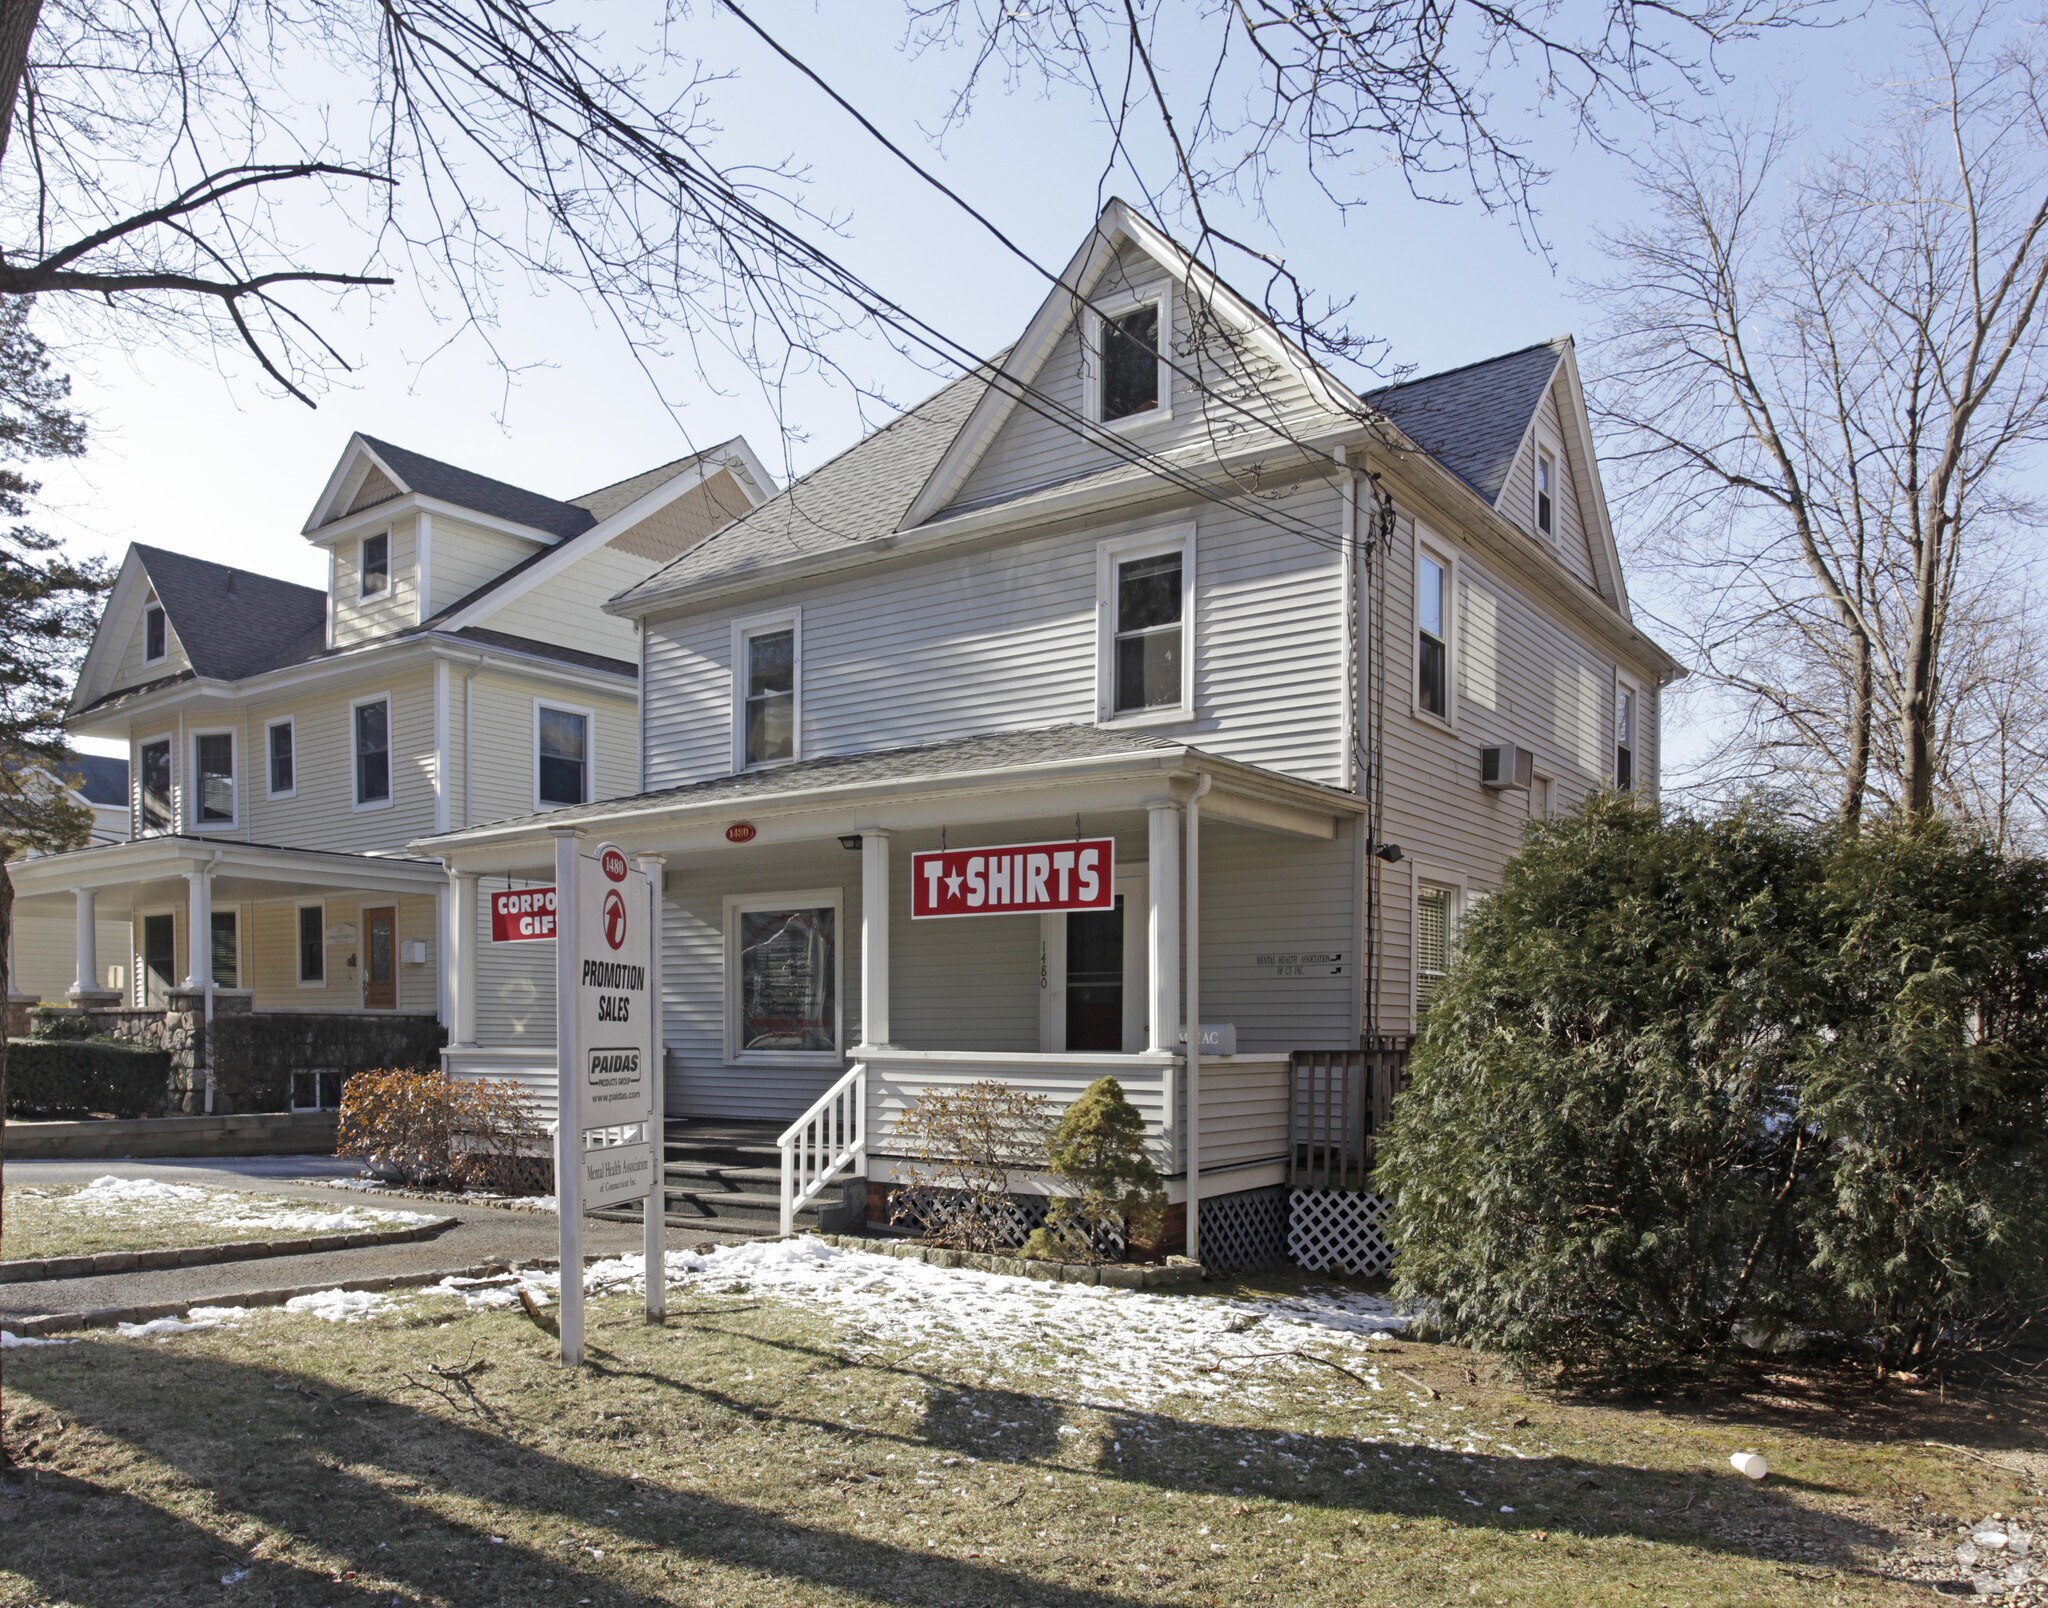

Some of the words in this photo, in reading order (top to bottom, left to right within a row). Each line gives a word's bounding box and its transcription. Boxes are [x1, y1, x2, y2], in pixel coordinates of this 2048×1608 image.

[729, 827, 749, 838] 1480
[605, 856, 624, 876] 1480
[519, 915, 557, 936] GIF
[1256, 956, 1276, 965] MENTAL
[1278, 955, 1298, 965] HEALTH
[1301, 954, 1331, 964] ASSOCIATION
[582, 959, 645, 991] PROMOTION
[1276, 967, 1283, 976] OF
[1285, 966, 1292, 976] CT
[598, 995, 630, 1022] SALES
[1178, 1031, 1218, 1045] MAC
[591, 1054, 639, 1074] PAIDAS
[598, 1078, 618, 1087] PRODUCTS
[618, 1077, 631, 1086] GROUP
[592, 1090, 640, 1103] www.paidas.com
[587, 1162, 604, 1181] Mental
[605, 1160, 621, 1177] Health
[622, 1157, 648, 1174] Association
[605, 1180, 629, 1191] Connecticut
